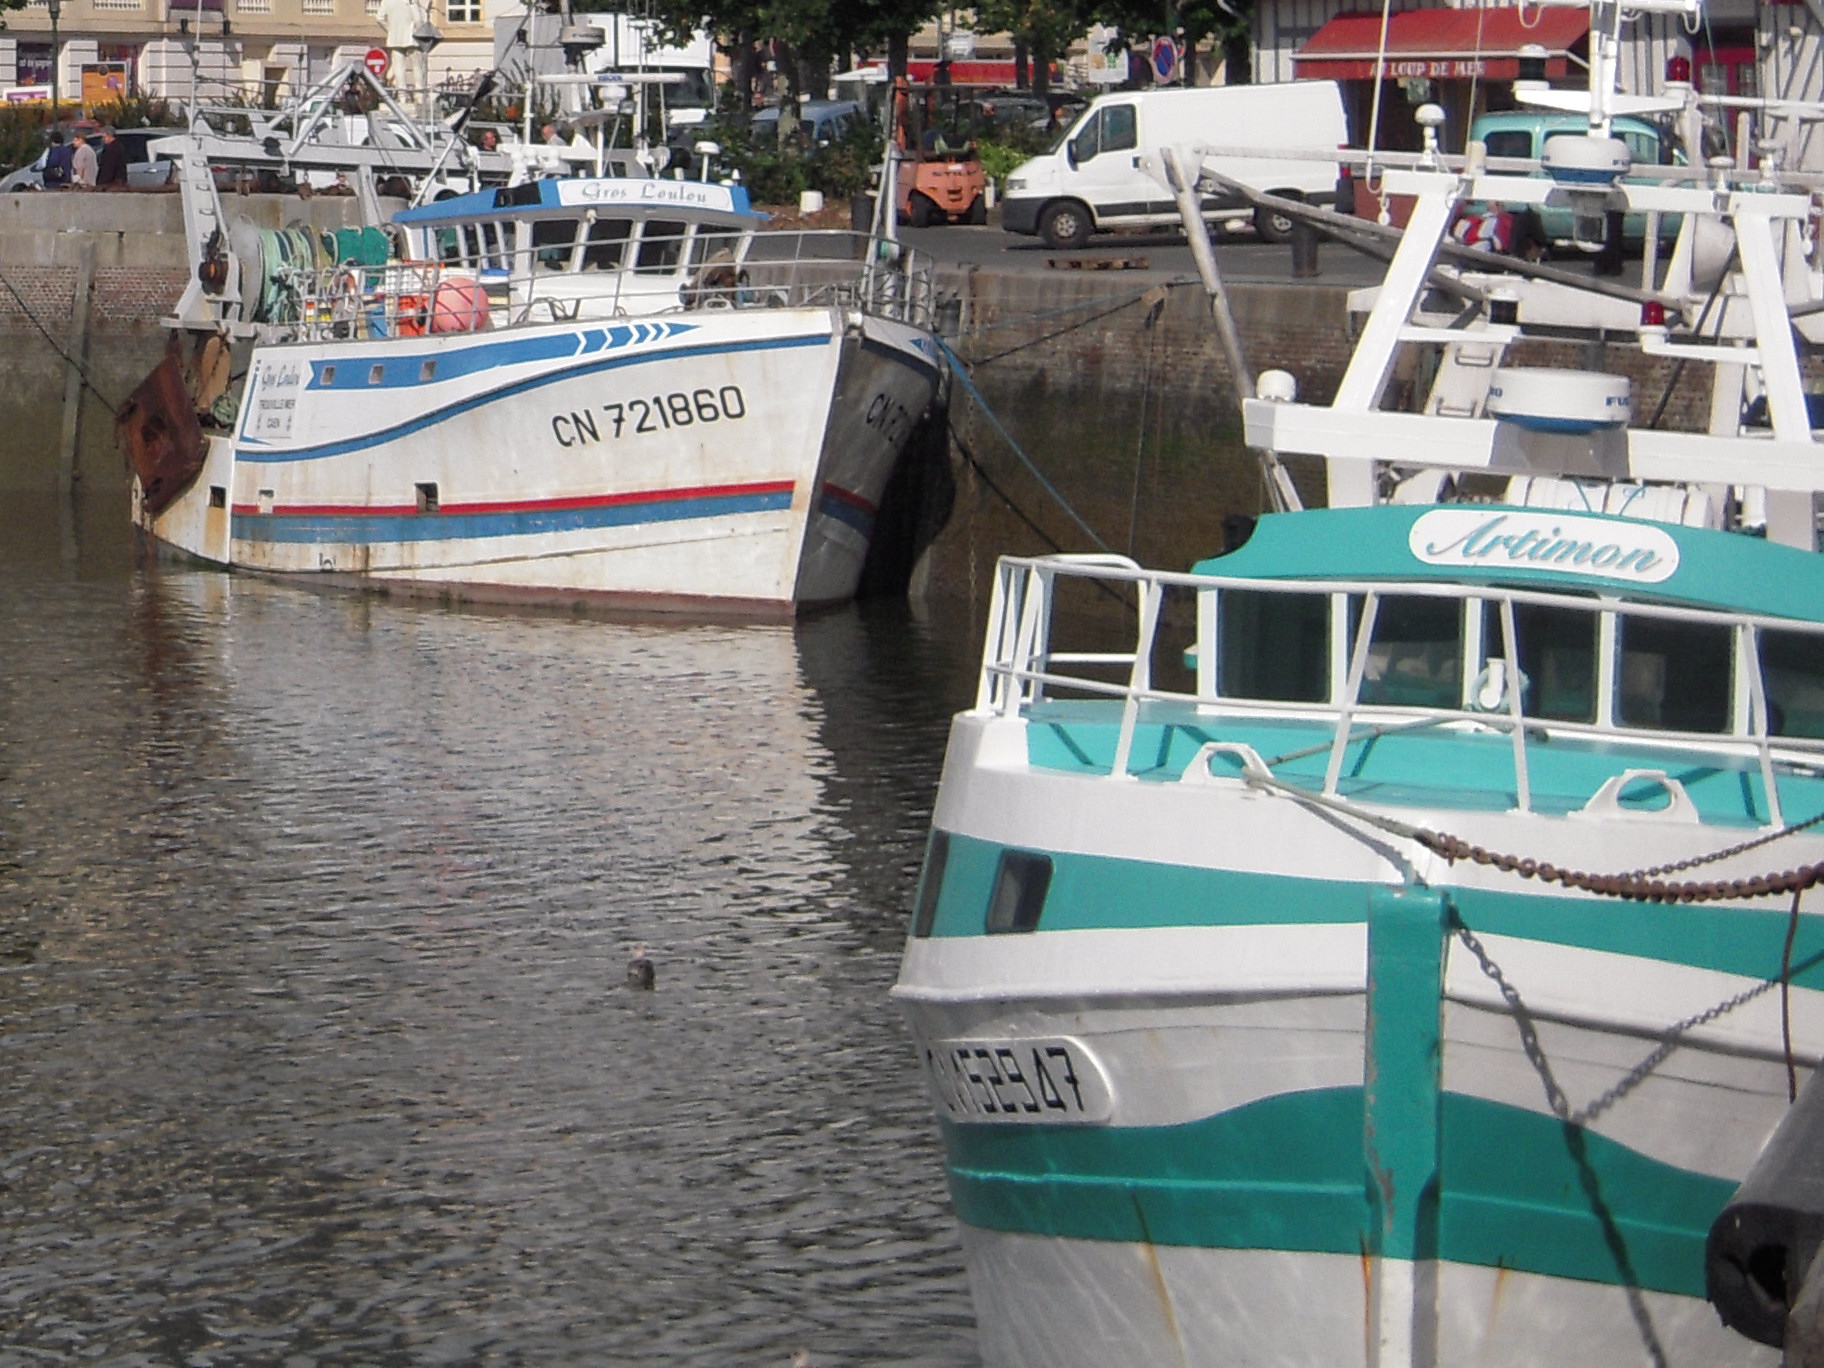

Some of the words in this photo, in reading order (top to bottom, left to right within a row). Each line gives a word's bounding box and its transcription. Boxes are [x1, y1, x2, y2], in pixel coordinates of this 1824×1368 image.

[1390, 62, 1427, 76] LOUP
[1430, 62, 1449, 76] DE
[581, 182, 627, 200] Gros
[641, 182, 707, 203] Loulou
[552, 409, 601, 448] CN
[603, 385, 746, 438] 721860
[1426, 515, 1663, 573] Artimon
